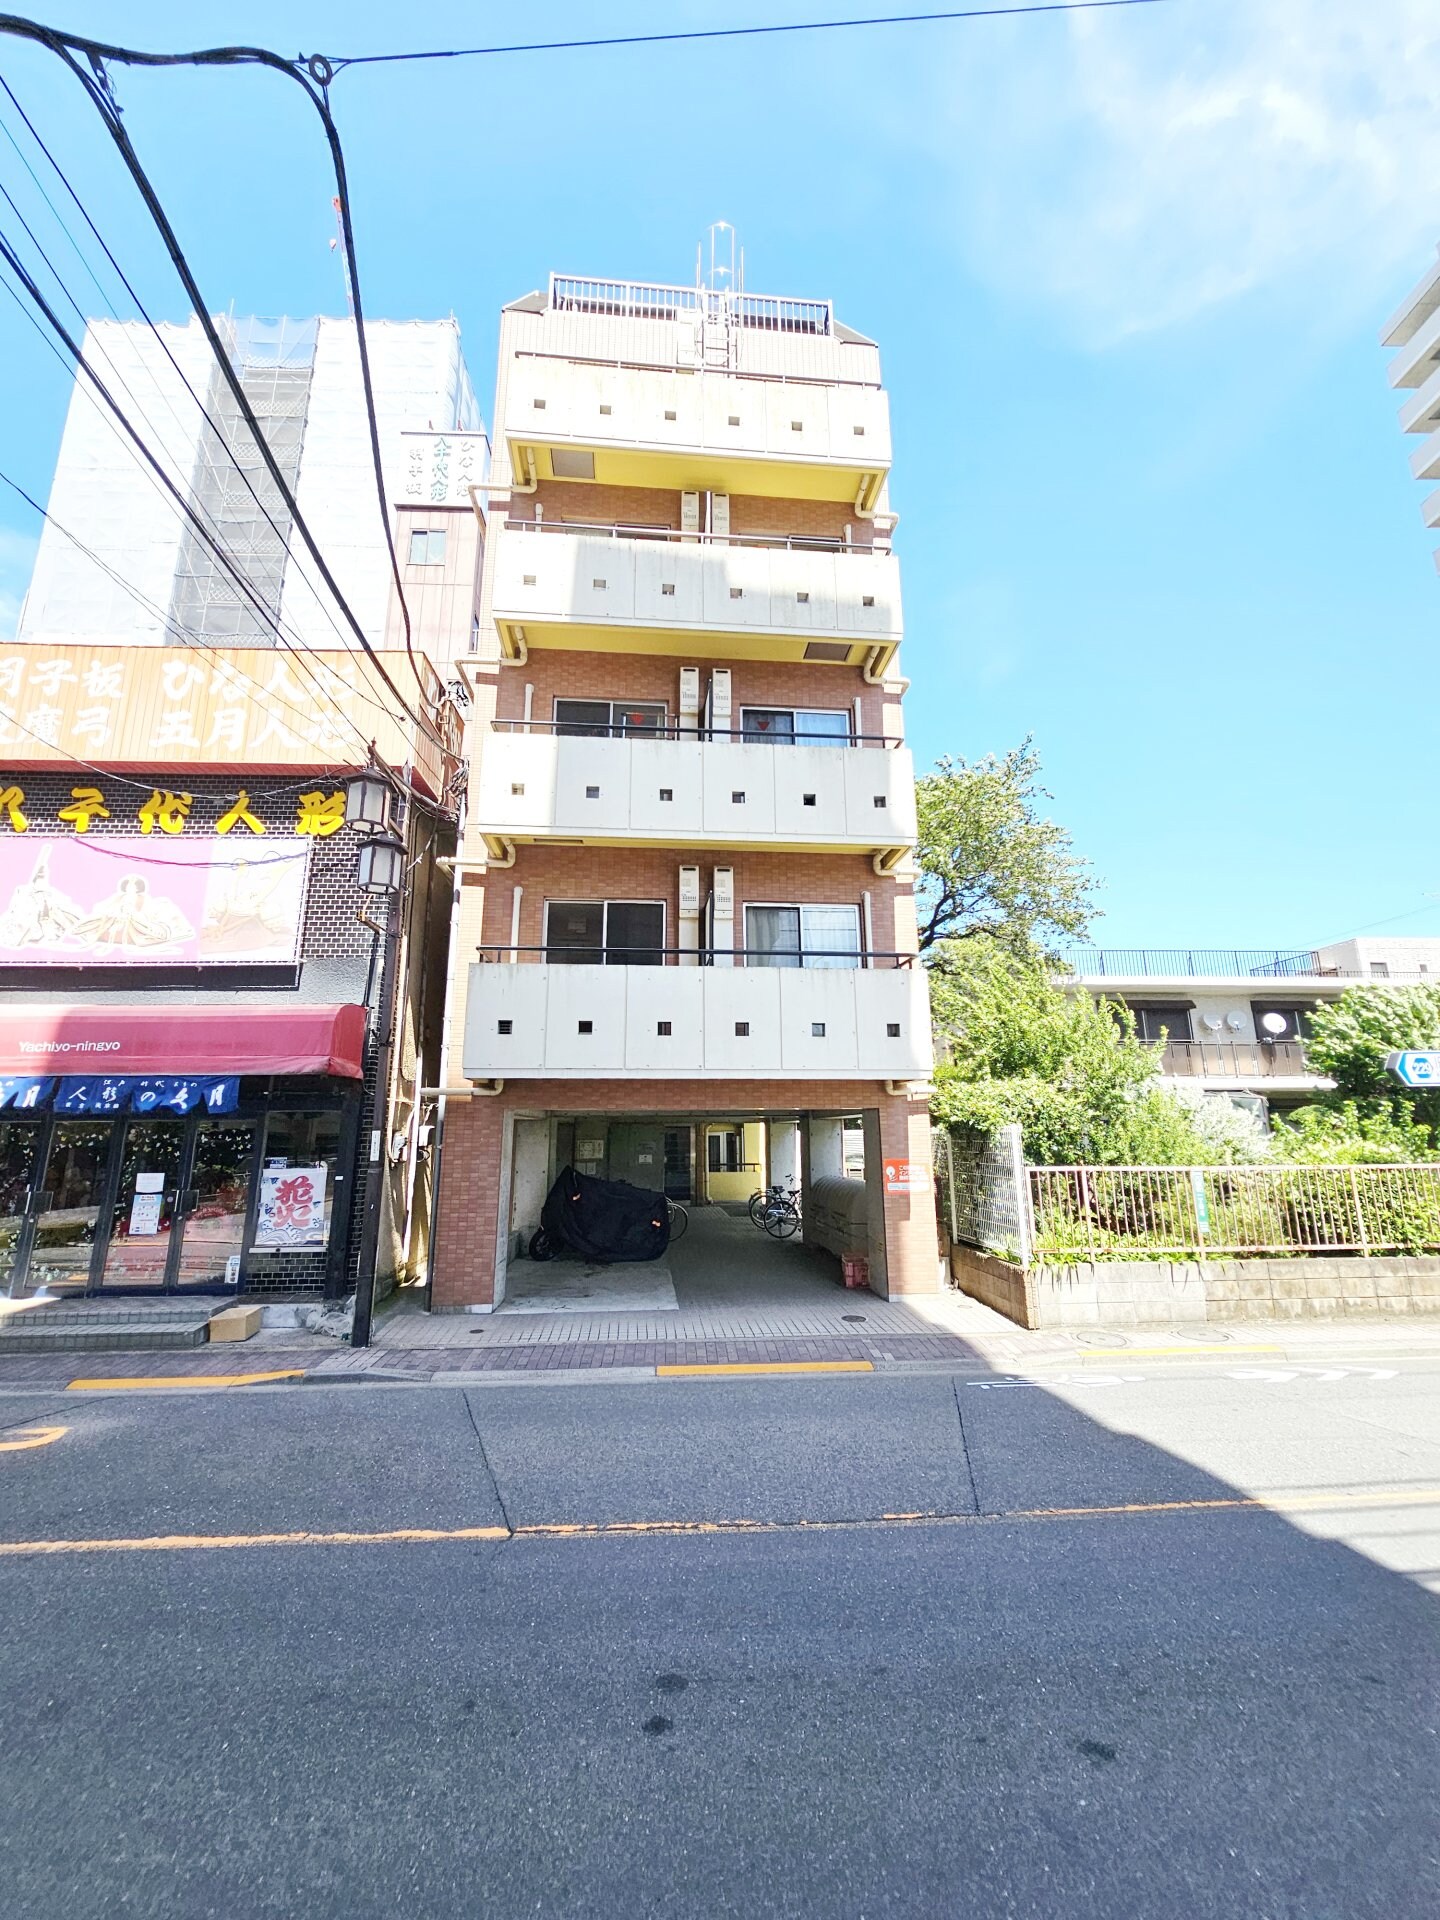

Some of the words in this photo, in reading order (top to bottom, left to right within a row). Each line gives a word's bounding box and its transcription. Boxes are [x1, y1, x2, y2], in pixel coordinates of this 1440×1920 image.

[162, 659, 357, 702] ひな人形
[149, 708, 355, 752] 五月人形
[19, 1040, 121, 1053] Yachiyo-ningyo
